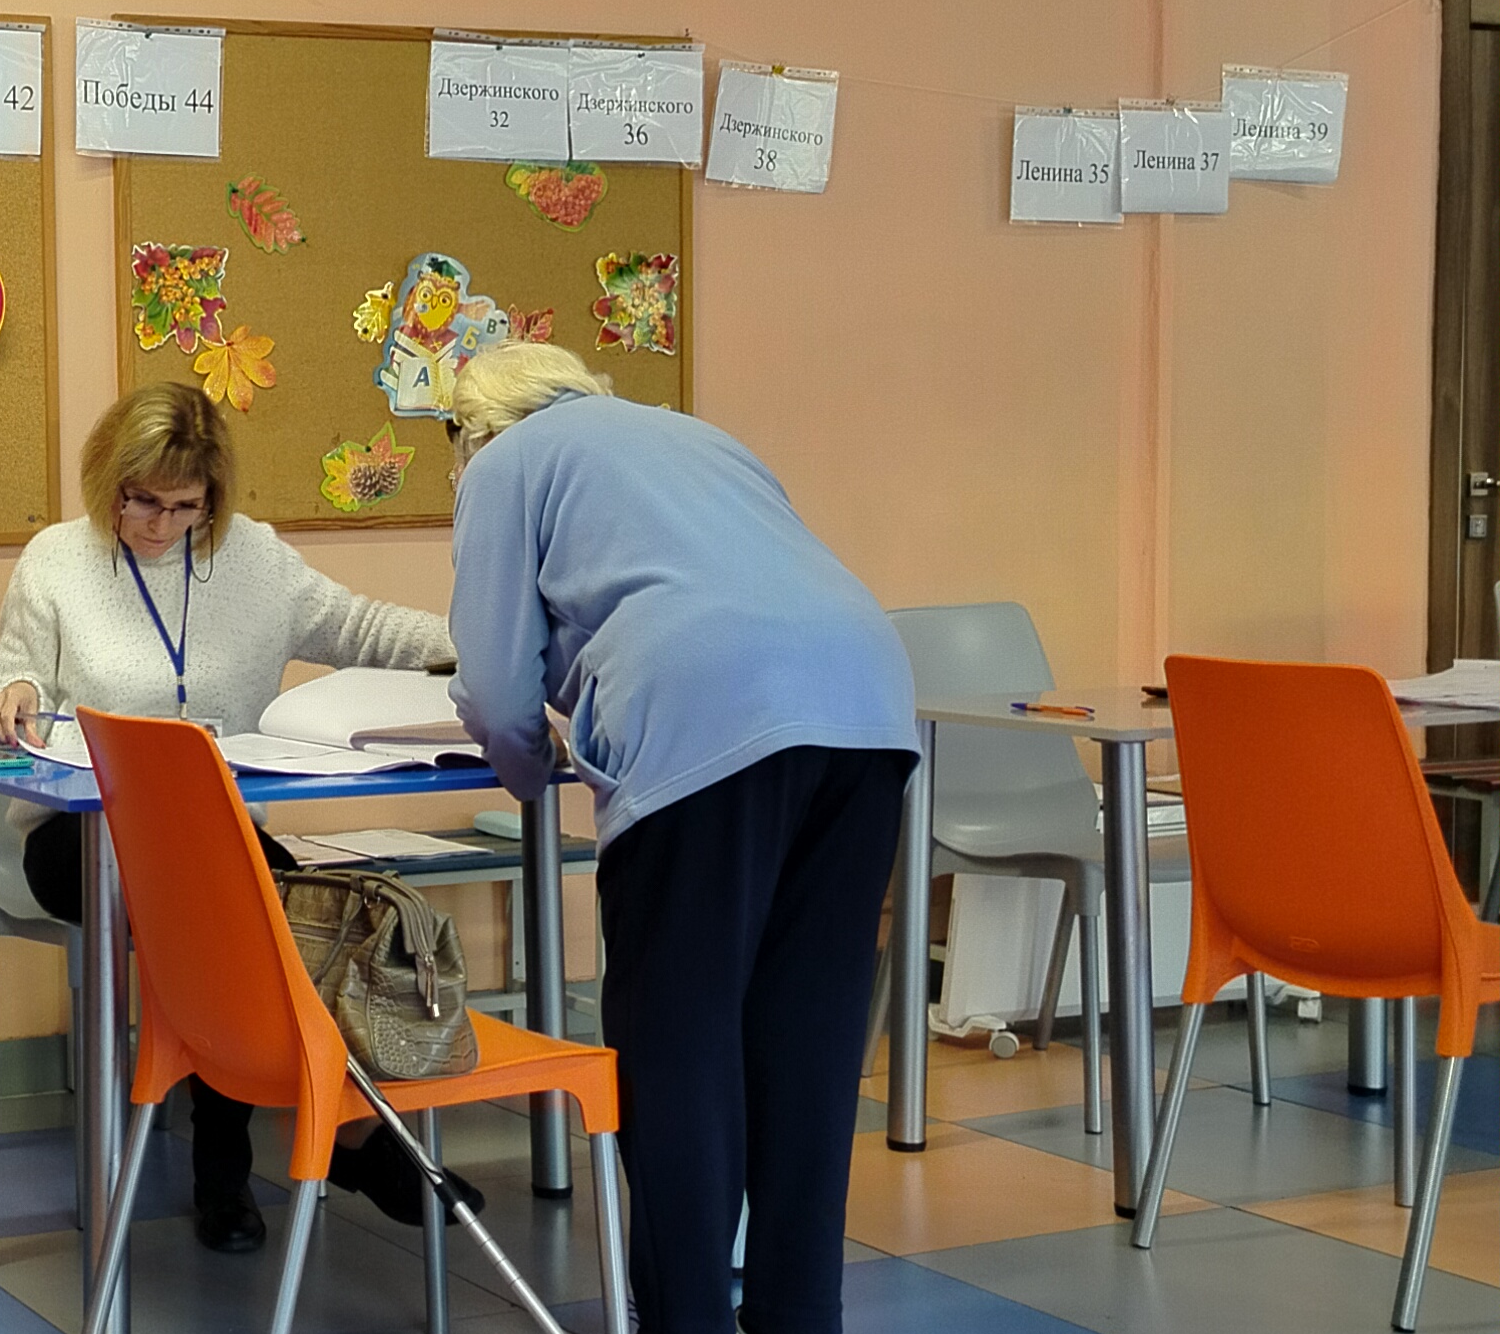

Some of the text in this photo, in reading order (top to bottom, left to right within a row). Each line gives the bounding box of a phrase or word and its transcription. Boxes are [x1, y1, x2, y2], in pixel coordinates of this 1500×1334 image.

[3, 85, 35, 111] 42
[82, 79, 214, 113] Победы 44
[438, 78, 560, 101] Дзержинского
[577, 92, 694, 116] Дзержинского
[489, 111, 510, 128] 32
[719, 113, 823, 147] Дзержинского
[1233, 118, 1328, 142] Ленина 39
[623, 123, 649, 146] 36
[753, 148, 778, 173] 38
[1016, 160, 1110, 185] Ленина 35
[1133, 149, 1220, 172] Ленина 37
[462, 325, 481, 350] Б
[486, 318, 498, 335] В
[412, 366, 430, 387] А
